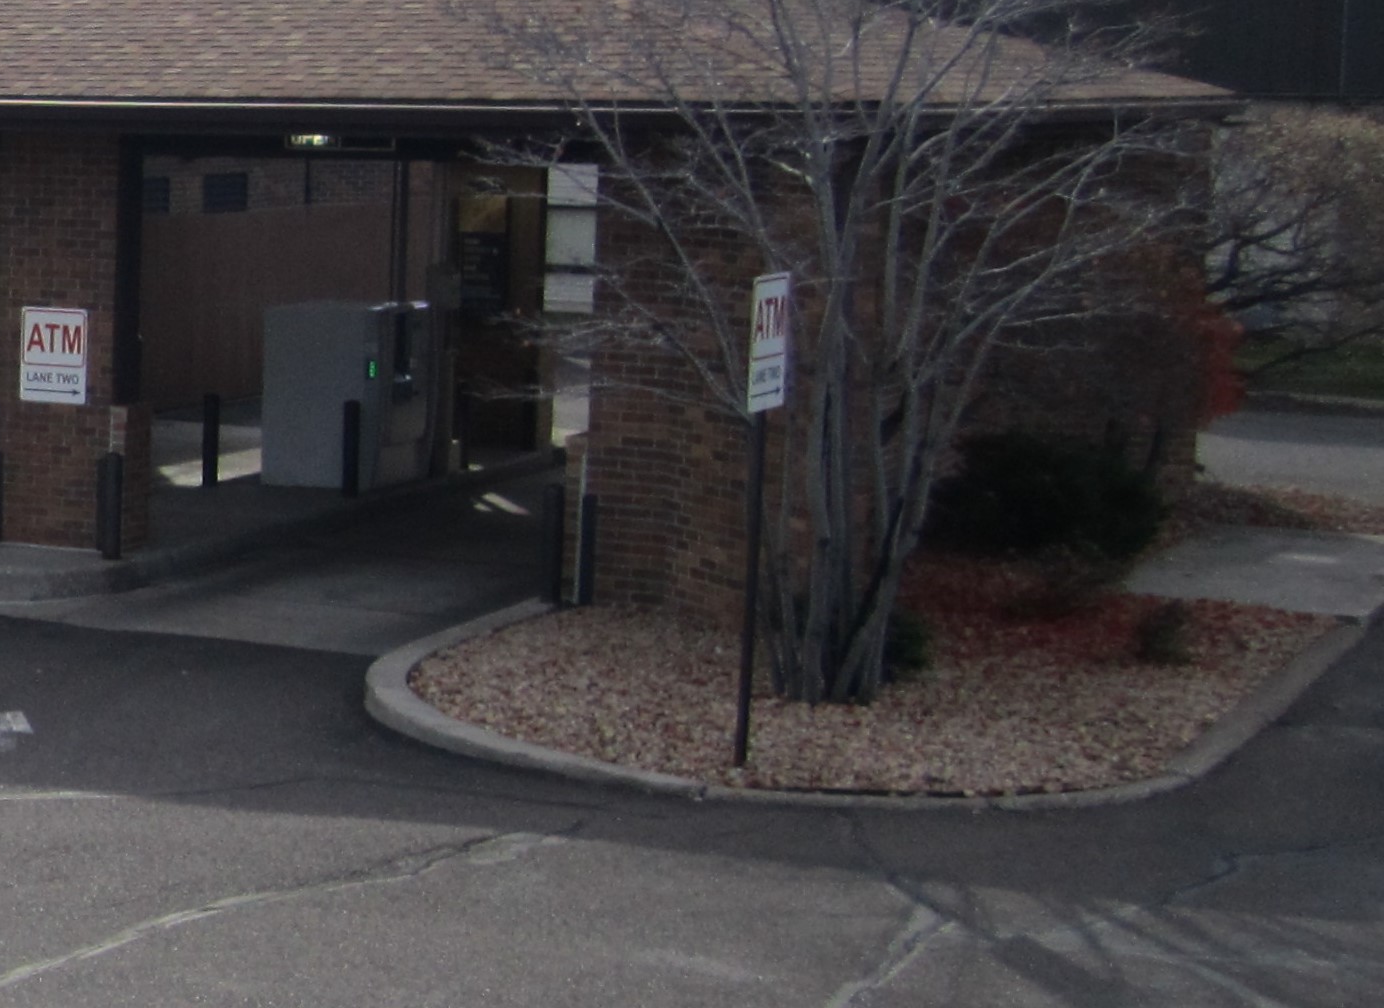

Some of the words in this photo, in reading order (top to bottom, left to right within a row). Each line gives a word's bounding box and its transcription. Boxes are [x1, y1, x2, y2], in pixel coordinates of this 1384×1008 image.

[752, 295, 785, 343] ATM
[27, 322, 82, 355] ATM
[26, 372, 53, 384] LANE
[56, 373, 79, 385] TWO
